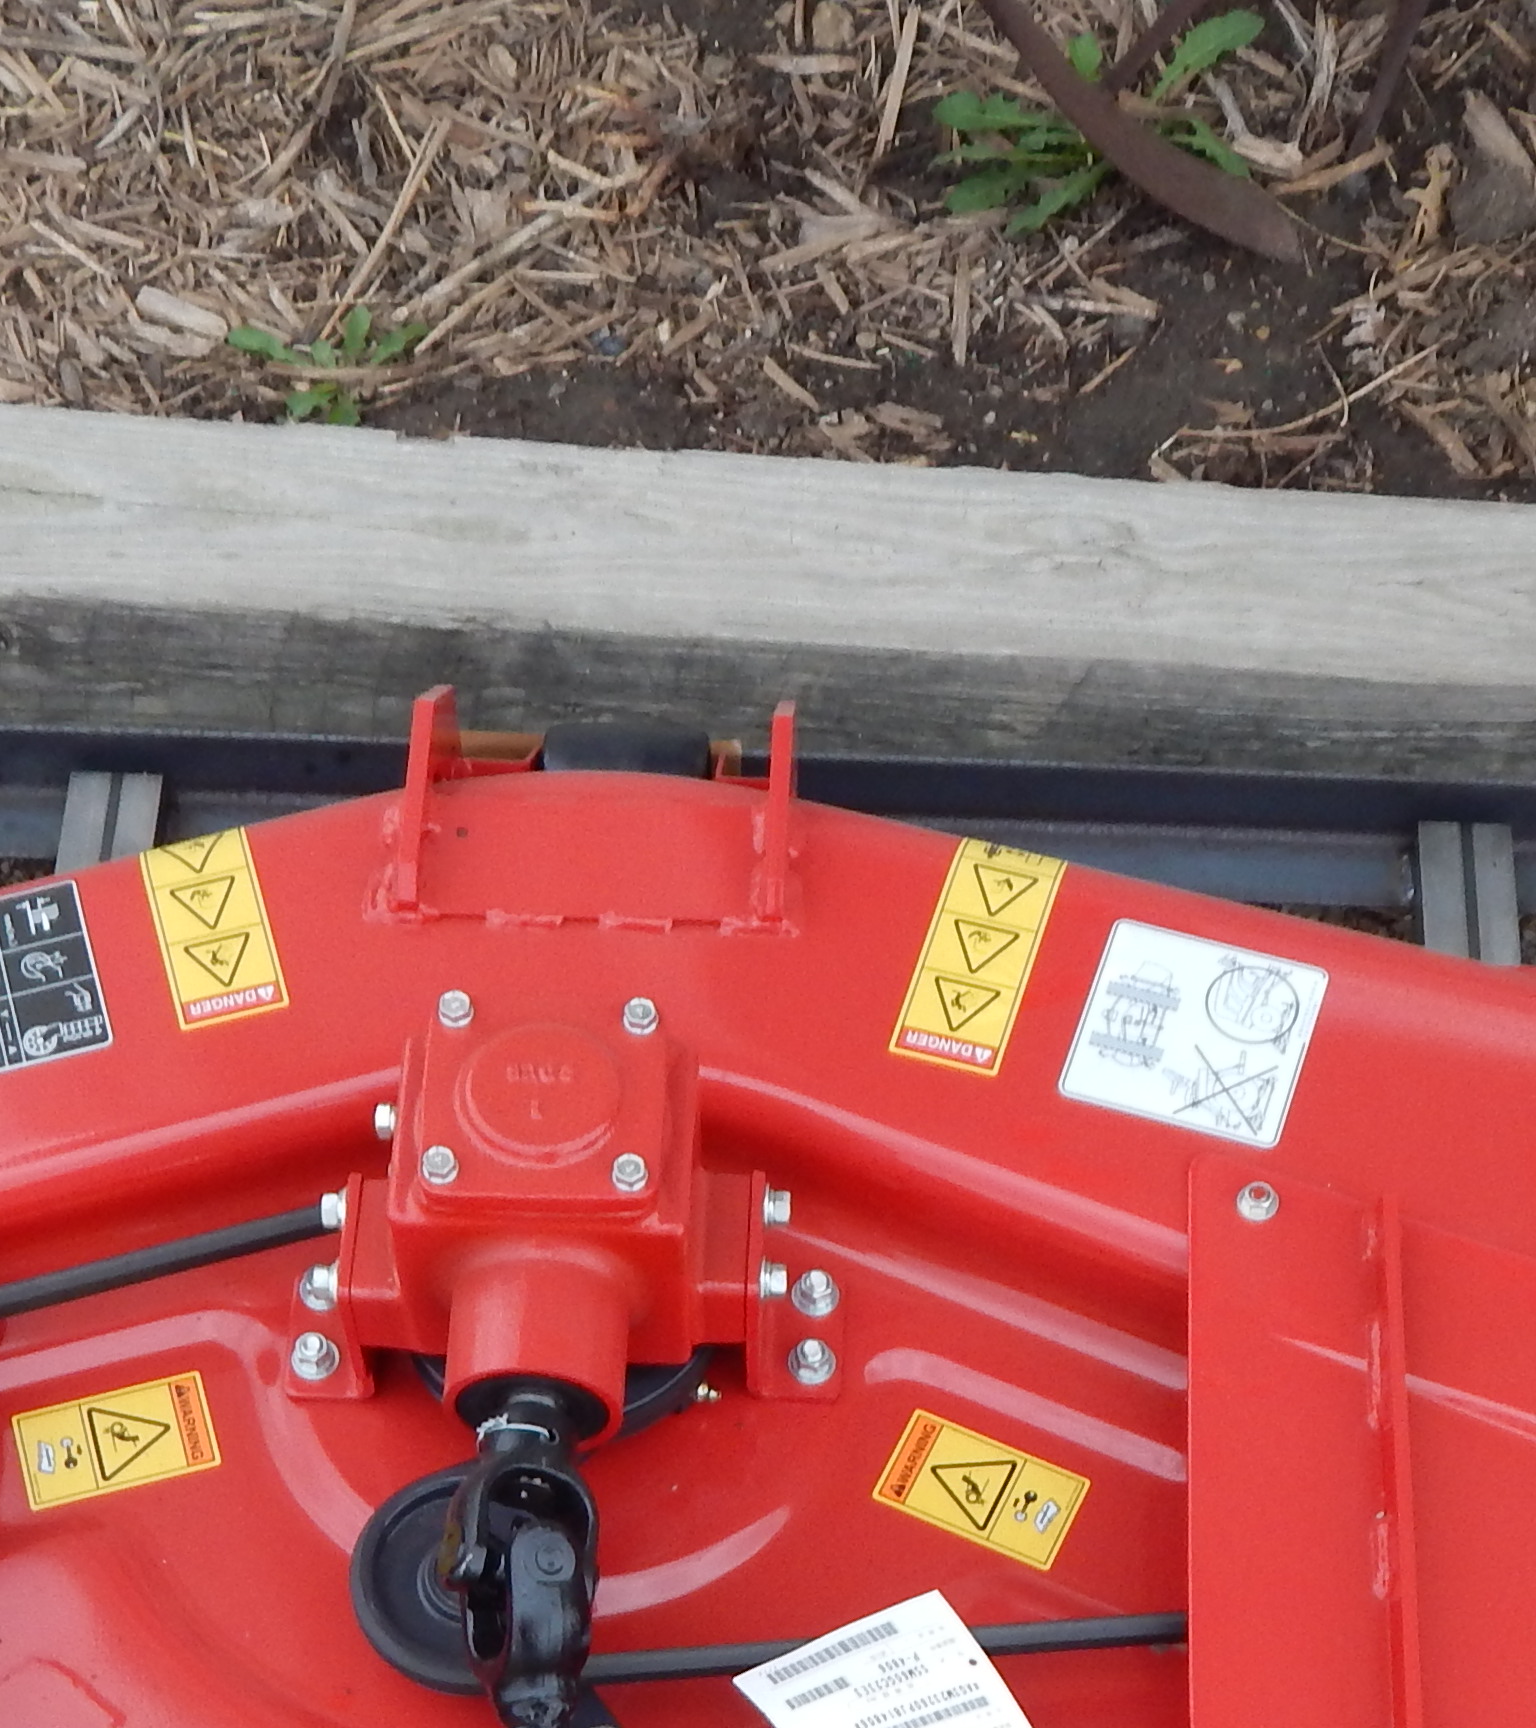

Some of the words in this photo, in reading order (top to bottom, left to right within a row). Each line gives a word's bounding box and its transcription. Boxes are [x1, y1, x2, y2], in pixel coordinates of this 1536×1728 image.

[189, 988, 257, 1016] DANGER
[905, 1030, 973, 1057] DANGER
[179, 1396, 204, 1460] WARNING
[897, 1423, 937, 1483] WARNING
